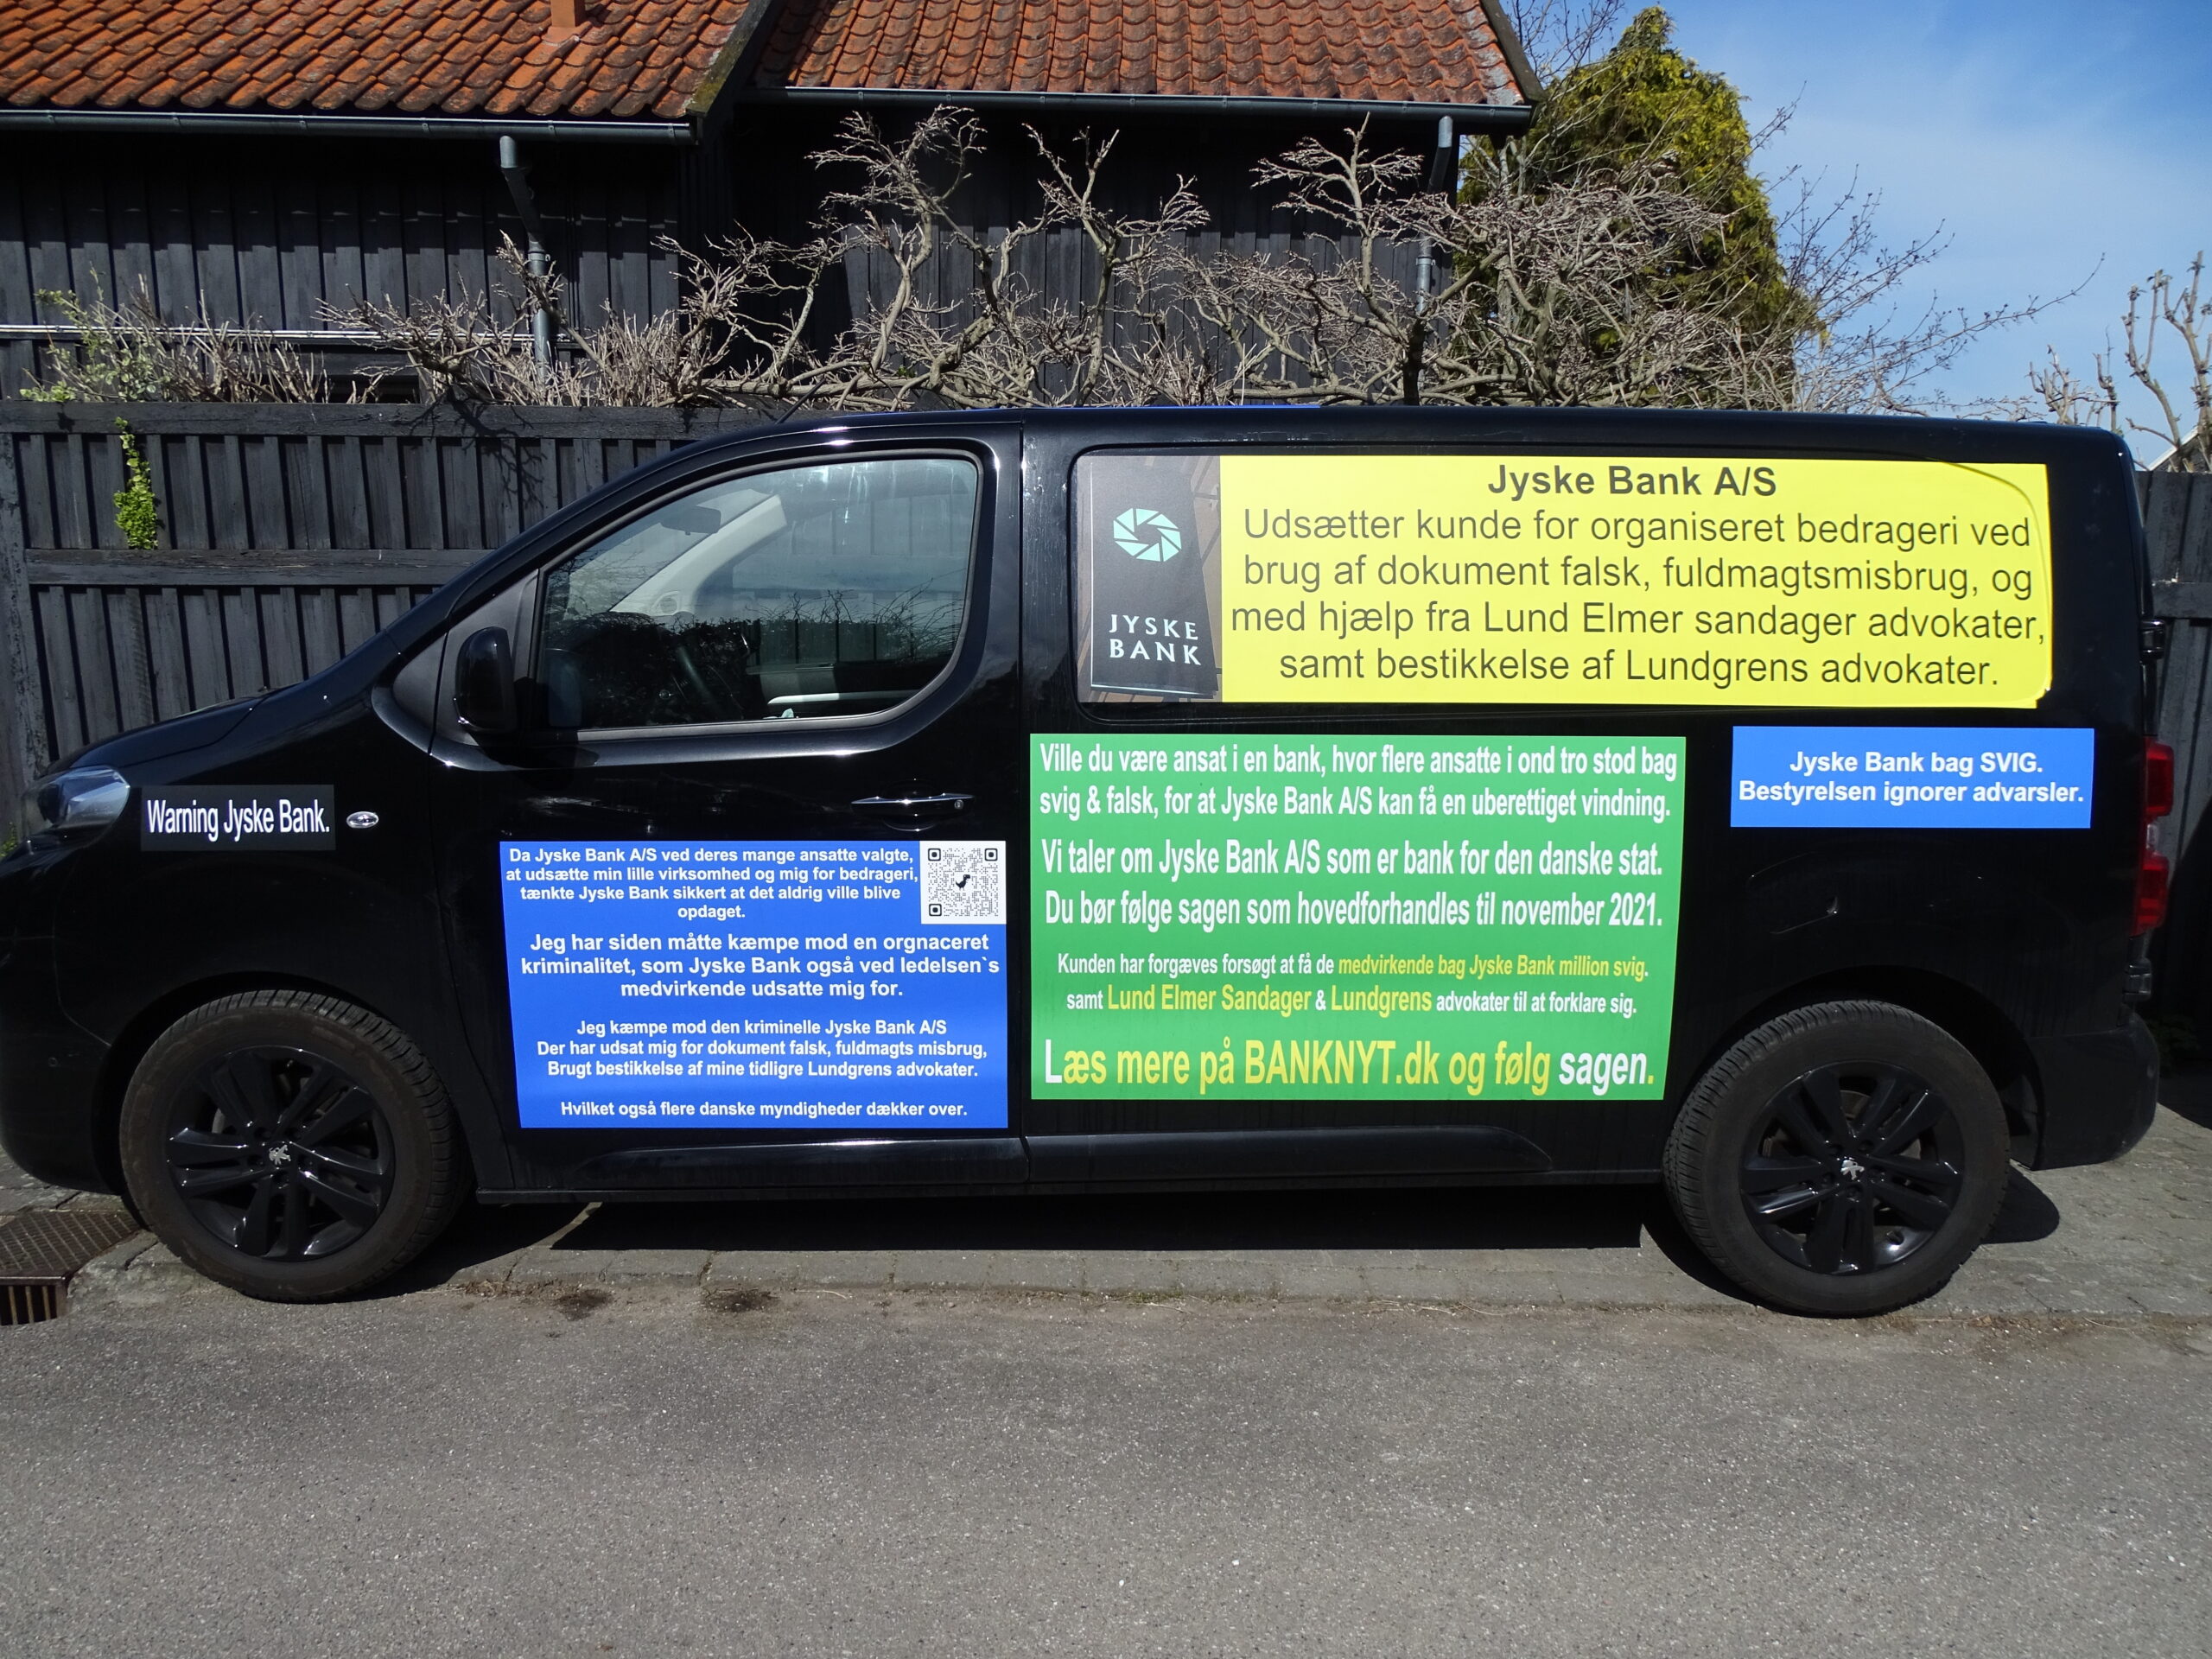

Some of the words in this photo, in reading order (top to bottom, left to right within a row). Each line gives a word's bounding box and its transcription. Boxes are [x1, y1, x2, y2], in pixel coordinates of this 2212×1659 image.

[1489, 465, 1594, 501] Jyske
[1609, 466, 1701, 494] Bank
[1713, 467, 1777, 496] A/S
[1246, 509, 1404, 538] Udsætter
[1418, 509, 1521, 539] kunde
[1534, 510, 1579, 539] for
[1592, 512, 1784, 548] organiseret
[1798, 513, 1957, 552] bedrageri
[1971, 518, 2029, 546] ved
[1246, 555, 1319, 592] brug
[1335, 555, 1367, 584] af
[1378, 555, 1549, 585] dokument
[1561, 556, 1649, 591] falsk,
[1663, 556, 1977, 599] fuldmagtsmisbrug,
[1993, 570, 2031, 601] og
[1109, 614, 1198, 640] JYSKE
[1233, 601, 1304, 631] med
[1321, 601, 1413, 639] hjælp
[1426, 601, 1470, 632] fra
[1485, 601, 1567, 632] Lund
[1584, 602, 1683, 633] Elmer
[1695, 605, 1856, 644] sandager
[1869, 607, 2043, 644] advokater,
[1110, 639, 1201, 665] BANK
[1281, 650, 1364, 678] samt
[1378, 648, 1568, 679] bestikkelse
[1583, 649, 1615, 679] af
[1628, 650, 1808, 689] Lundgrens
[1821, 652, 1997, 684] advokater.
[1040, 743, 1082, 772] Ville
[1089, 744, 1112, 772] du
[1119, 751, 1167, 772] være
[1173, 745, 1227, 772] ansat
[1233, 744, 1237, 772] i
[1244, 751, 1267, 772] en
[1274, 744, 1325, 777] bank,
[1332, 745, 1376, 772] hvor
[1382, 745, 1424, 772] flere
[1430, 747, 1501, 773] ansatte
[1508, 746, 1512, 772] i
[1518, 746, 1554, 773] ond
[1560, 747, 1587, 773] tro
[1593, 747, 1635, 774] stod
[1642, 747, 1676, 781] bag
[1790, 752, 1858, 776] Jyske
[1866, 752, 1923, 772] Bank
[1932, 753, 1973, 777] bag
[1980, 753, 2042, 772] SVIG.
[1740, 781, 1876, 805] Bestyrelsen
[1885, 781, 1967, 805] ignorer
[1974, 782, 2082, 801] advarsler.
[148, 800, 219, 842] Warning
[224, 799, 274, 842] Jyske
[279, 799, 329, 833] Bank.
[510, 849, 531, 861] Da
[535, 849, 581, 865] Jyske
[586, 849, 625, 861] Bank
[630, 849, 657, 861] A/S
[662, 849, 690, 861] ved
[695, 849, 737, 861] deres
[743, 851, 795, 864] mange
[800, 849, 857, 861] ansatte
[861, 849, 912, 864] valgte,
[1042, 839, 1061, 872] Vi
[1069, 839, 1116, 873] taler
[1121, 848, 1152, 873] om
[1160, 839, 1219, 882] Jyske
[1227, 839, 1278, 873] Bank
[1284, 839, 1320, 874] A/S
[1327, 849, 1370, 874] som
[1377, 849, 1398, 874] er
[1404, 841, 1453, 874] bank
[1460, 840, 1490, 874] for
[1495, 841, 1532, 874] den
[1539, 841, 1612, 874] danske
[1619, 843, 1662, 875] stat.
[506, 868, 521, 880] at
[526, 868, 588, 880] udsætte
[594, 868, 622, 880] min
[627, 868, 654, 880] lille
[658, 868, 750, 880] virksomhed
[755, 870, 774, 883] og
[780, 868, 808, 883] mig
[813, 867, 835, 880] for
[840, 868, 918, 883] bedrageri,
[678, 905, 745, 920] opdaget.
[1046, 890, 1073, 924] Du
[1081, 891, 1116, 924] bør
[1121, 890, 1172, 932] følge
[1179, 899, 1240, 932] sagen
[1247, 899, 1290, 924] som
[1298, 891, 1469, 925] hovedforhandles
[1477, 892, 1495, 925] til
[1502, 893, 1605, 925] november
[1609, 893, 1662, 925] 2021.
[531, 934, 565, 954] Jeg
[572, 934, 603, 950] har
[609, 934, 661, 950] siden
[669, 932, 721, 950] måtte
[728, 934, 798, 953] kæmpe
[805, 934, 847, 950] mod
[854, 938, 876, 950] en
[884, 934, 988, 953] orgnaceret
[522, 957, 635, 976] kriminalitet,
[642, 962, 683, 973] som
[690, 957, 745, 977] Jyske
[752, 957, 801, 973] Bank
[807, 956, 854, 976] også
[860, 957, 893, 973] ved
[621, 981, 745, 995] medvirkende
[753, 981, 823, 995] udsatte
[830, 981, 864, 1000] mig
[870, 980, 902, 995] for.
[1067, 991, 1103, 1009] samt
[1109, 985, 1154, 1009] Lund
[1162, 984, 1216, 1009] Elmer
[1222, 984, 1312, 1017] Sandager
[1316, 990, 1326, 1010] &
[1332, 985, 1432, 1018] Lundgrens
[1437, 991, 1510, 1011] advokater
[1514, 991, 1527, 1011] til
[1531, 993, 1546, 1012] at
[1549, 991, 1606, 1013] forklare
[1611, 993, 1636, 1018] sig.
[577, 1021, 605, 1037] Jeg
[610, 1020, 667, 1037] kæmpe
[672, 1020, 706, 1033] mod
[711, 1020, 740, 1033] den
[745, 1020, 820, 1033] kriminelle
[825, 1020, 870, 1038] Jyske
[876, 1020, 915, 1033] Bank
[919, 1020, 946, 1034] A/S
[1046, 1039, 1106, 1084] Læs
[1118, 1051, 1189, 1084] mere
[1200, 1037, 1234, 1094] på
[1246, 1040, 1440, 1084] BANKNYT.dk
[1449, 1052, 1485, 1095] og
[1495, 1041, 1550, 1095] følg
[1560, 1053, 1653, 1096] sagen.
[562, 1102, 614, 1115] Hvilket
[619, 1101, 656, 1118] også
[660, 1102, 695, 1115] flere
[700, 1102, 755, 1115] danske
[760, 1102, 861, 1118] myndigheder
[867, 1103, 925, 1115] dækker
[929, 1105, 967, 1116] over.
